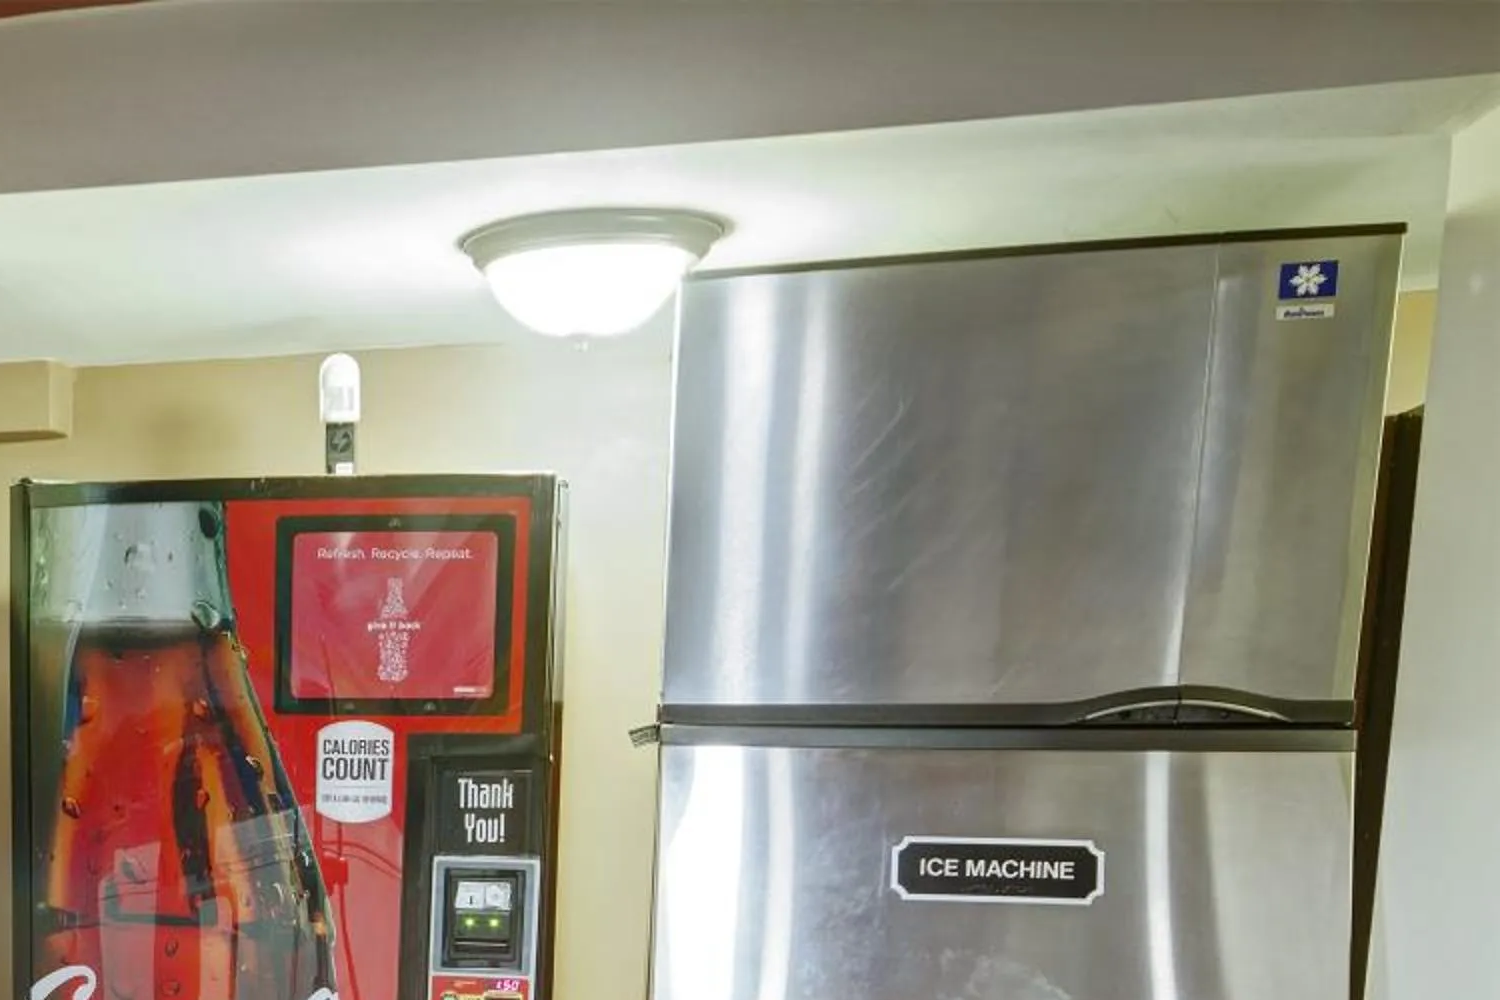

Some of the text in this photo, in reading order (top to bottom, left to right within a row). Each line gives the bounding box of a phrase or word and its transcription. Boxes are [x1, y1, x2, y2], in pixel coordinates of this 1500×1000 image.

[323, 739, 389, 755] CALORIES
[323, 757, 388, 781] COUNT
[458, 778, 514, 809] Thank
[465, 813, 505, 843] You!
[919, 858, 1075, 880] ICE MACHINE
